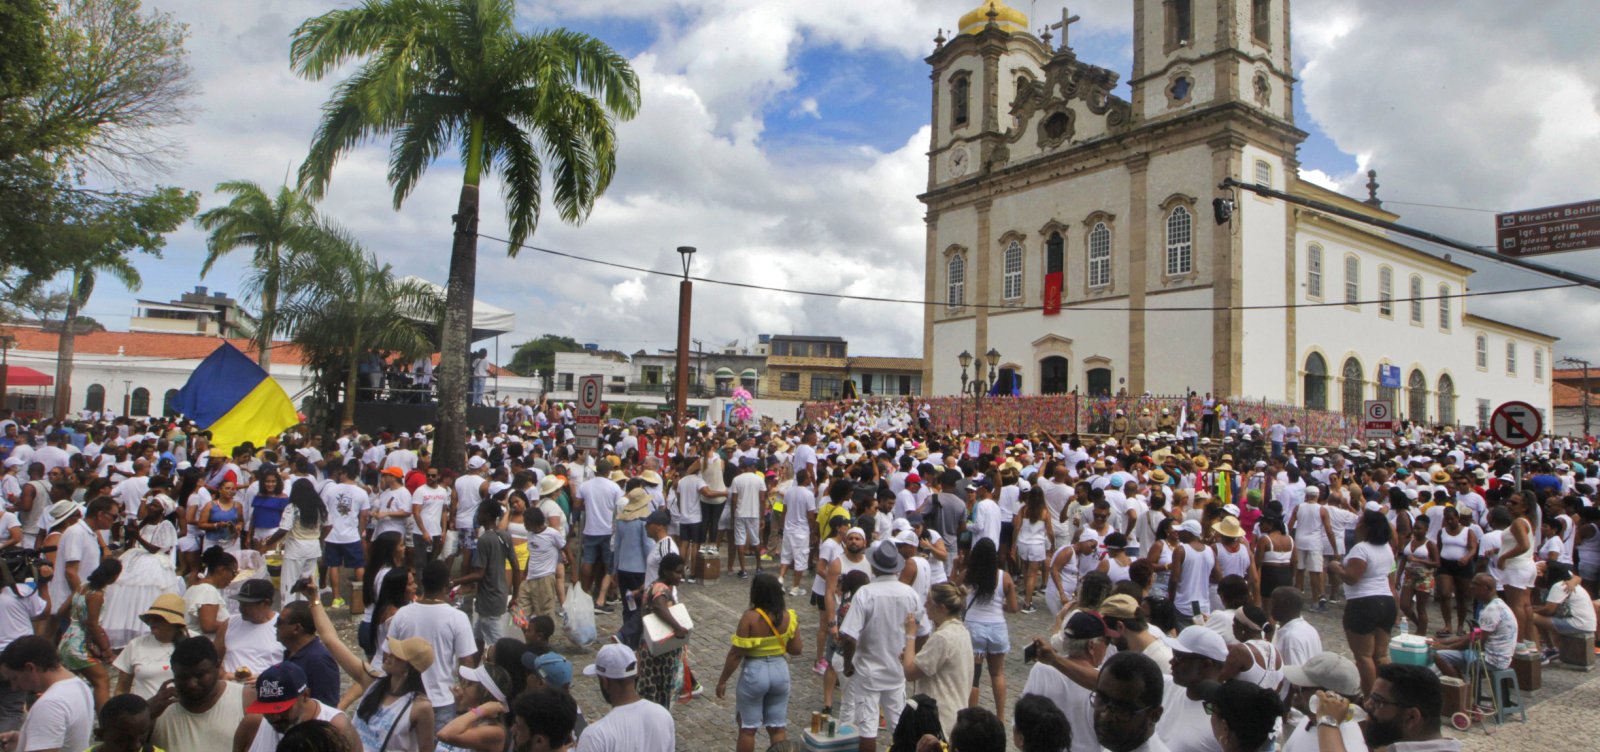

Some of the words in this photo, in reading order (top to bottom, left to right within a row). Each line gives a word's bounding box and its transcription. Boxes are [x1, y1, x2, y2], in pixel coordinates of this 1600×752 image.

[1518, 211, 1559, 223] Mirante
[1539, 223, 1579, 234] Bonfim
[1552, 233, 1566, 241] del
[1520, 244, 1550, 253] Bonfim
[1555, 239, 1587, 249] Church
[587, 385, 593, 402] E
[1375, 406, 1382, 416] E
[262, 679, 279, 688] ONE
[260, 686, 284, 697] PIECE
